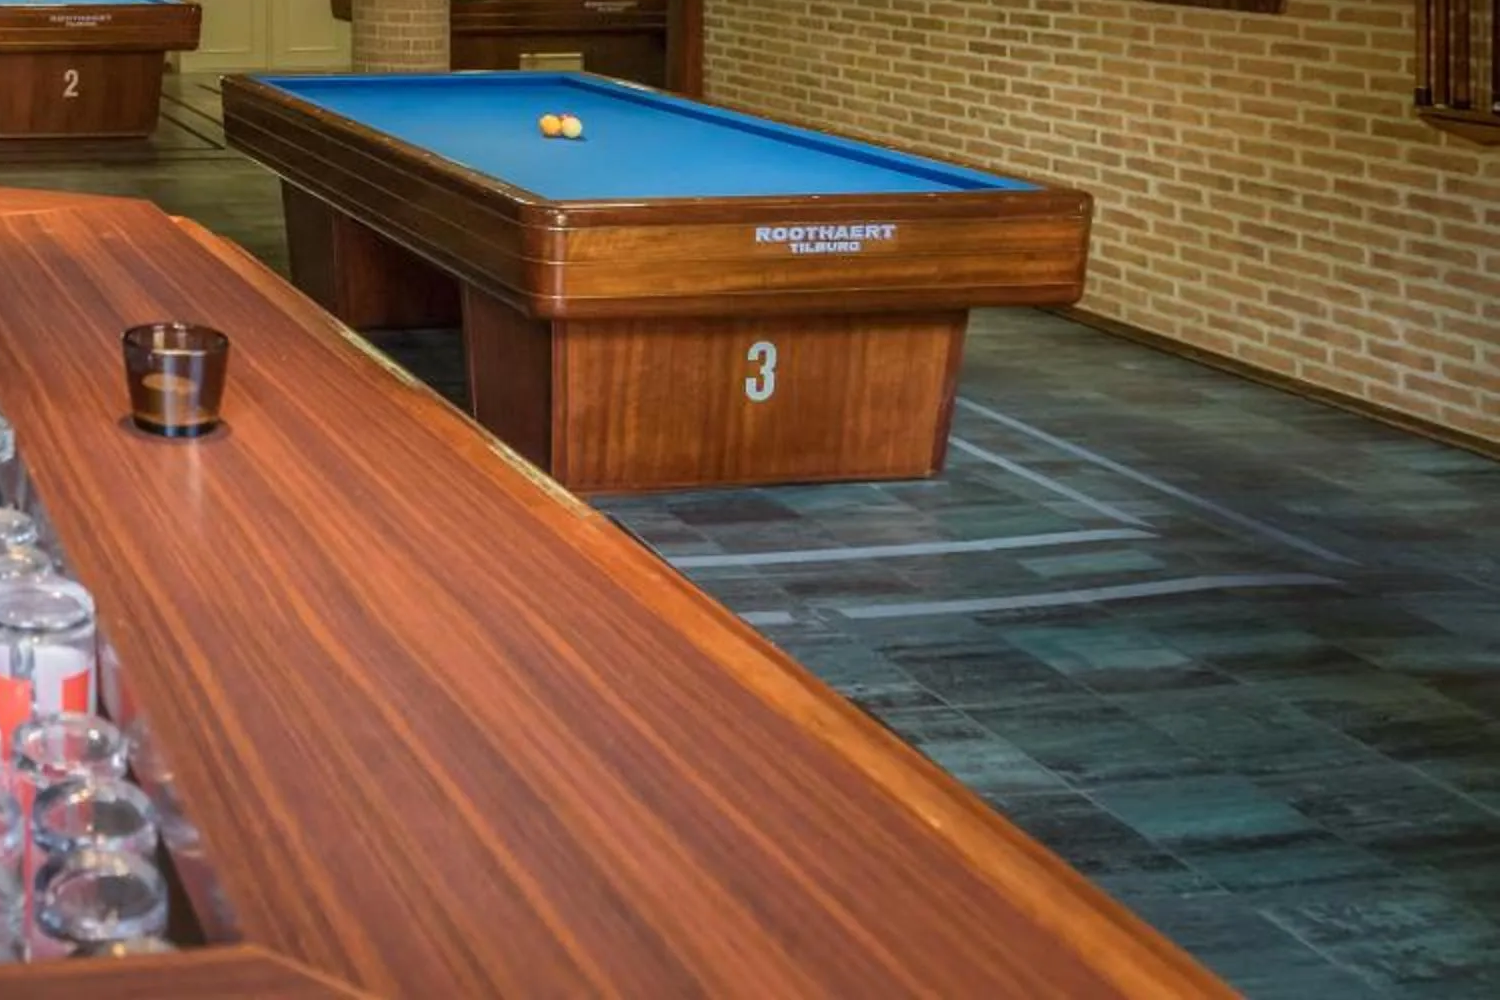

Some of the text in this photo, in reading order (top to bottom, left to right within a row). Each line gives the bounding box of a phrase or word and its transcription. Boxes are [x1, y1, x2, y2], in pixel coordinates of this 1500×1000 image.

[63, 69, 79, 97] 2
[755, 224, 897, 242] ROOTHAERT
[789, 241, 861, 254] TILBURG
[744, 340, 778, 401] 3
